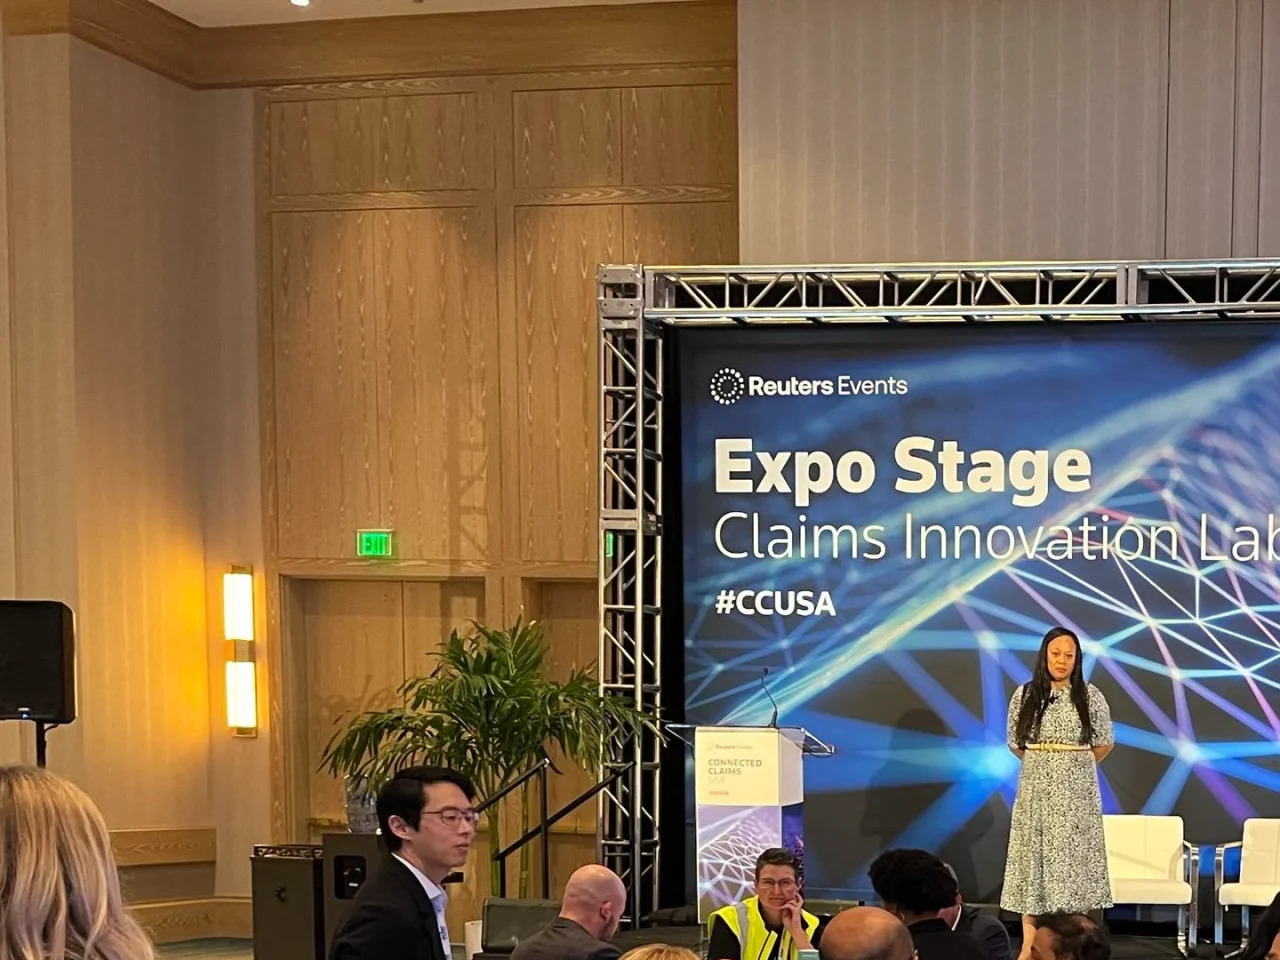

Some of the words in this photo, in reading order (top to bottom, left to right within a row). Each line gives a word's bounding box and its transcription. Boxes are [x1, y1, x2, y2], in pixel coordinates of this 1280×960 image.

[748, 376, 834, 396] Reuters
[837, 375, 909, 396] Events
[714, 437, 876, 507] Expo
[893, 436, 1093, 507] Stage
[362, 533, 387, 555] EXIT
[714, 511, 886, 562] Claims
[903, 512, 1180, 563] Innovation
[714, 588, 837, 618] #CCUSA
[708, 759, 763, 768] CONNECTED
[708, 767, 742, 776] CLAIMS
